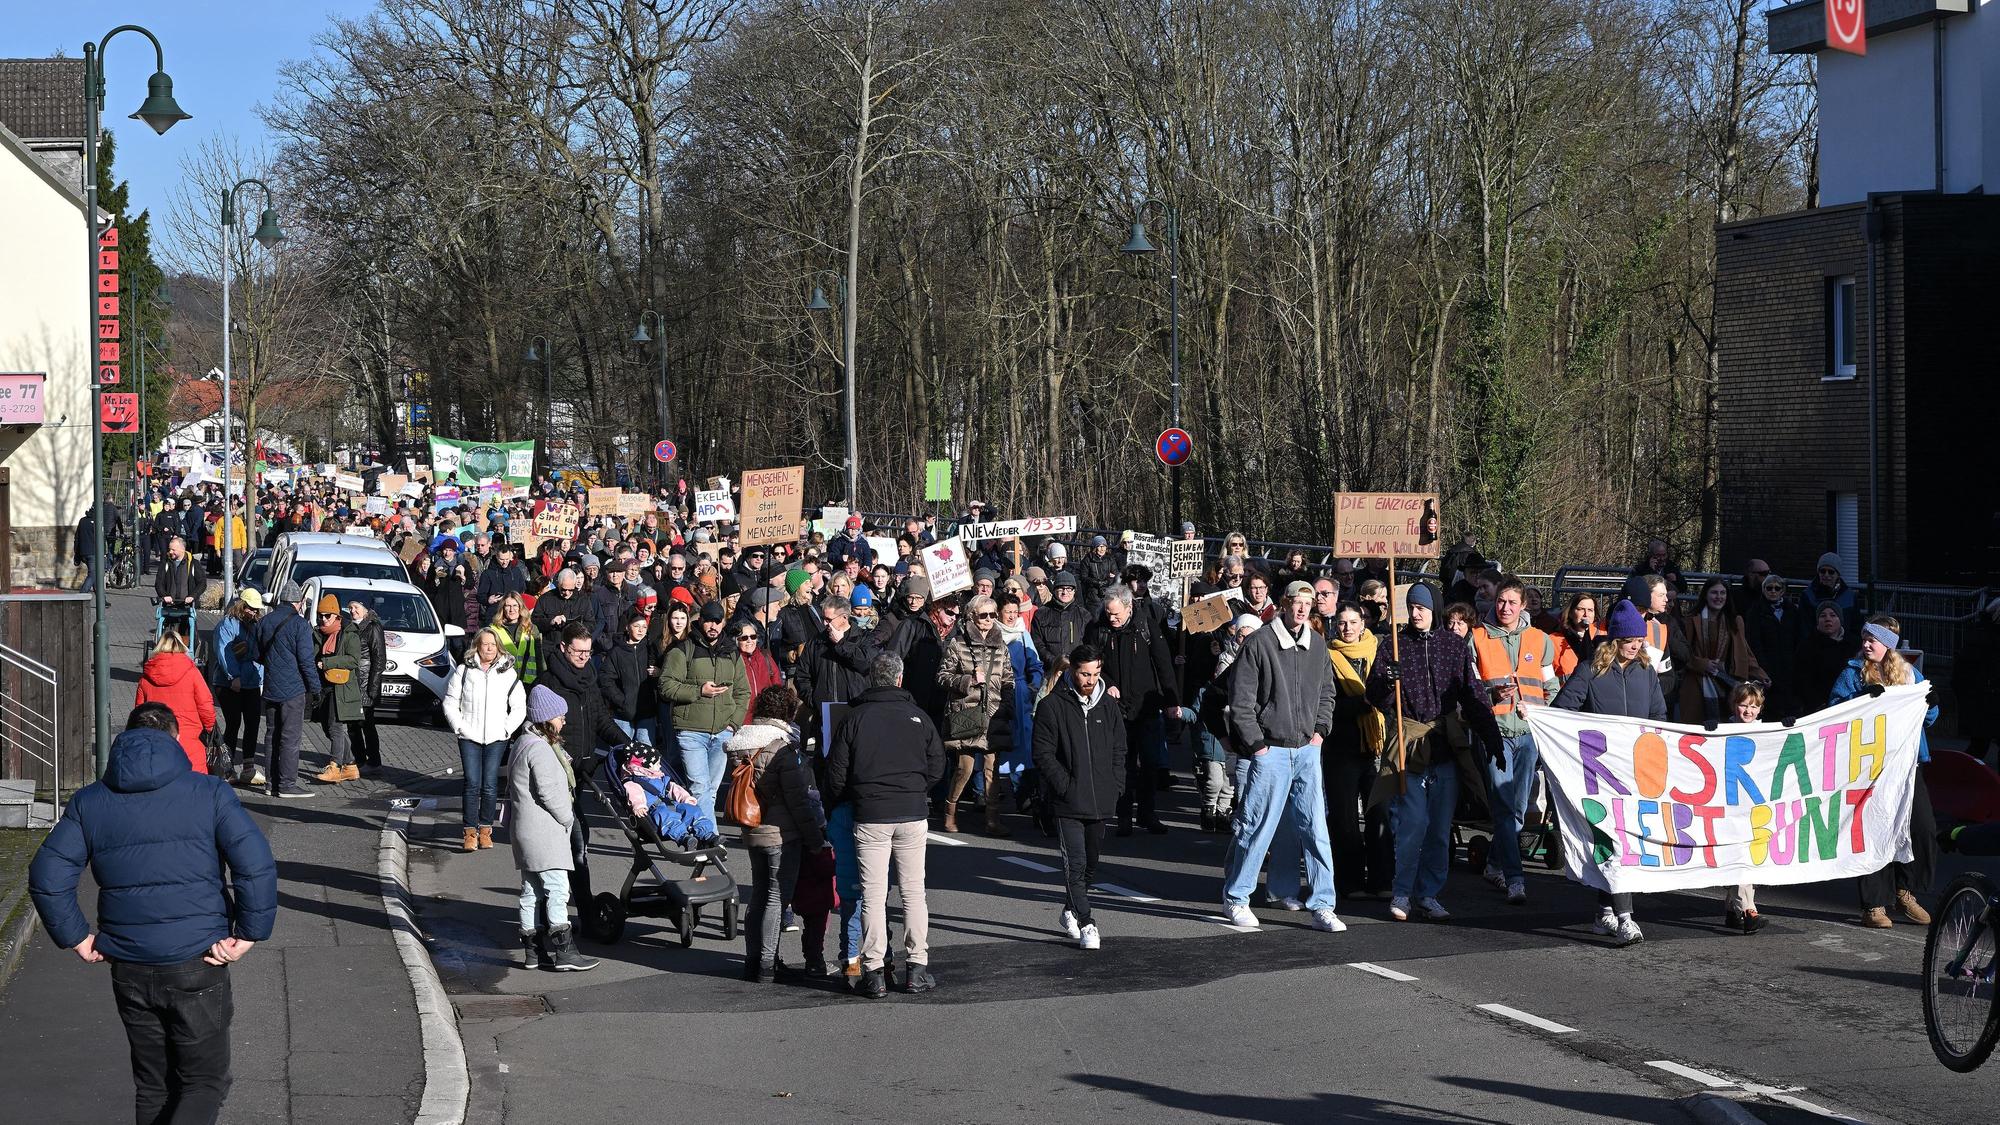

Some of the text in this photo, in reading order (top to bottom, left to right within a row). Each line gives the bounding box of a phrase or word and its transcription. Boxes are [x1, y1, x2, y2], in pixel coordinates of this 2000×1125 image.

[100, 325, 115, 334] 77
[20, 384, 37, 399] 77
[104, 396, 133, 405] Mr. Lee
[435, 452, 441, 463] 5
[450, 454, 459, 467] 12
[747, 471, 788, 487] MENSCHEN
[763, 483, 794, 498] RECHTE
[698, 504, 716, 515] AFD
[758, 501, 776, 511] statt
[1341, 497, 1367, 510] DIE
[565, 516, 577, 524] die
[756, 510, 783, 523] rechte
[534, 522, 574, 537] Vielfalt
[747, 524, 795, 539] MENSCHEN
[1343, 516, 1400, 535] braunen
[1146, 544, 1171, 554] Deutsch
[1174, 543, 1204, 553] KEINEN
[1341, 540, 1362, 553] DIE
[1366, 541, 1387, 553] WIR
[1173, 561, 1203, 571] WEITER
[382, 685, 393, 693] AP
[1578, 714, 1887, 806] RÖSRATH
[1581, 786, 1873, 868] BLEIBT BUNT
